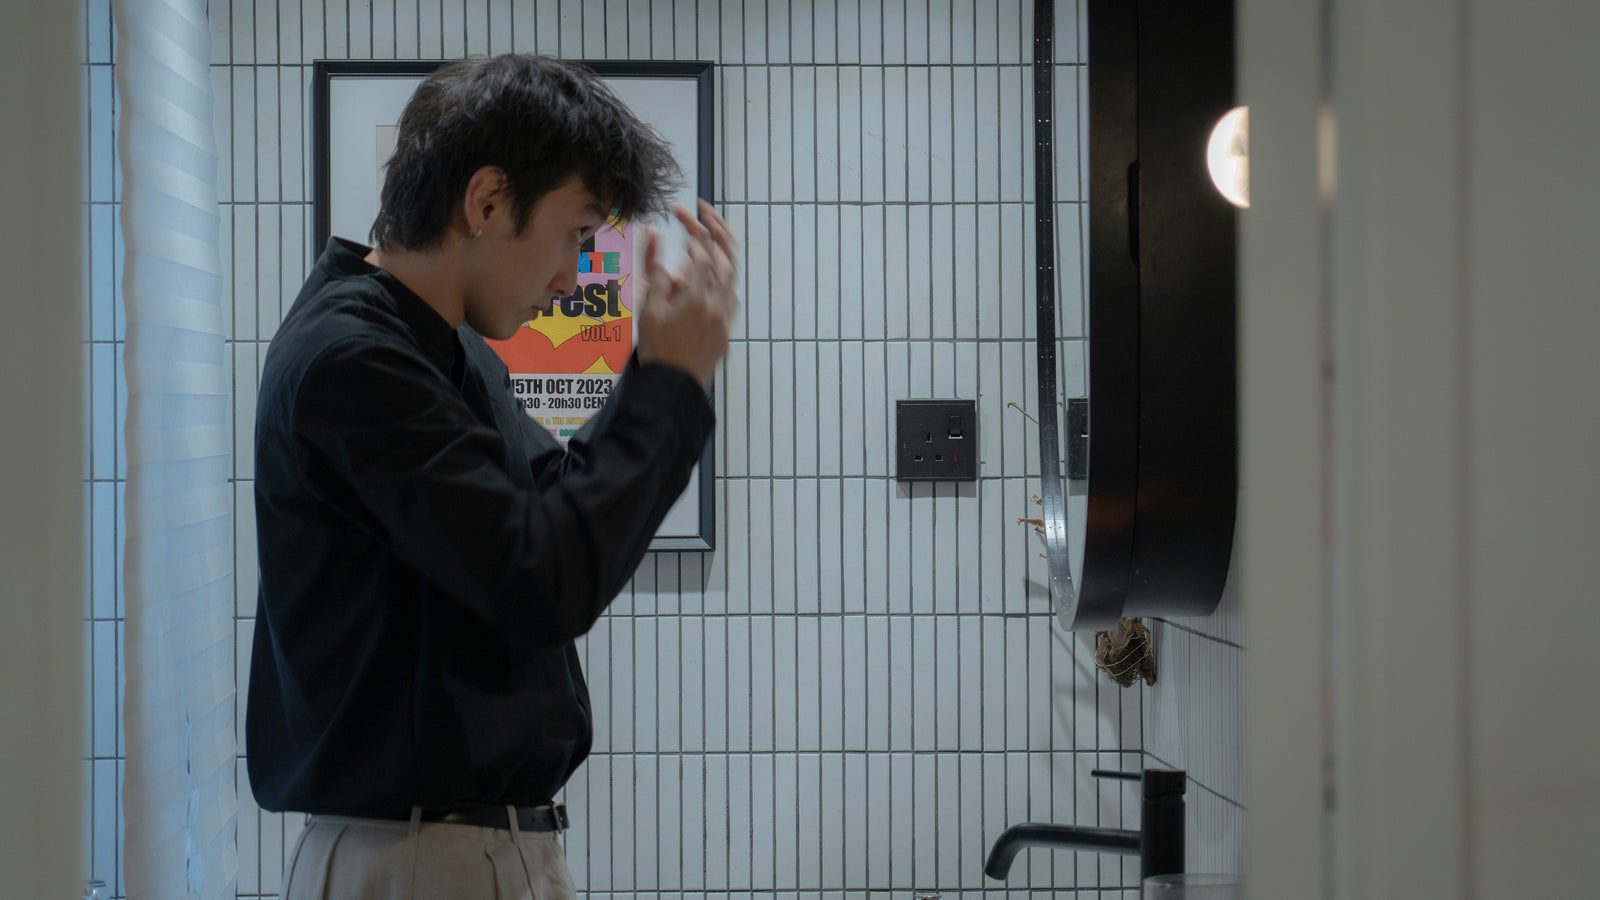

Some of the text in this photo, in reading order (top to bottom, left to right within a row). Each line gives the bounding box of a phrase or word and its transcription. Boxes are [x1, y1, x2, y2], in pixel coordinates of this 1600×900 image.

[580, 325, 620, 341] VOL. 1
[546, 379, 573, 394] OCT
[576, 379, 613, 395] 2023
[548, 397, 581, 409] 20h30
[552, 417, 565, 425] THE
